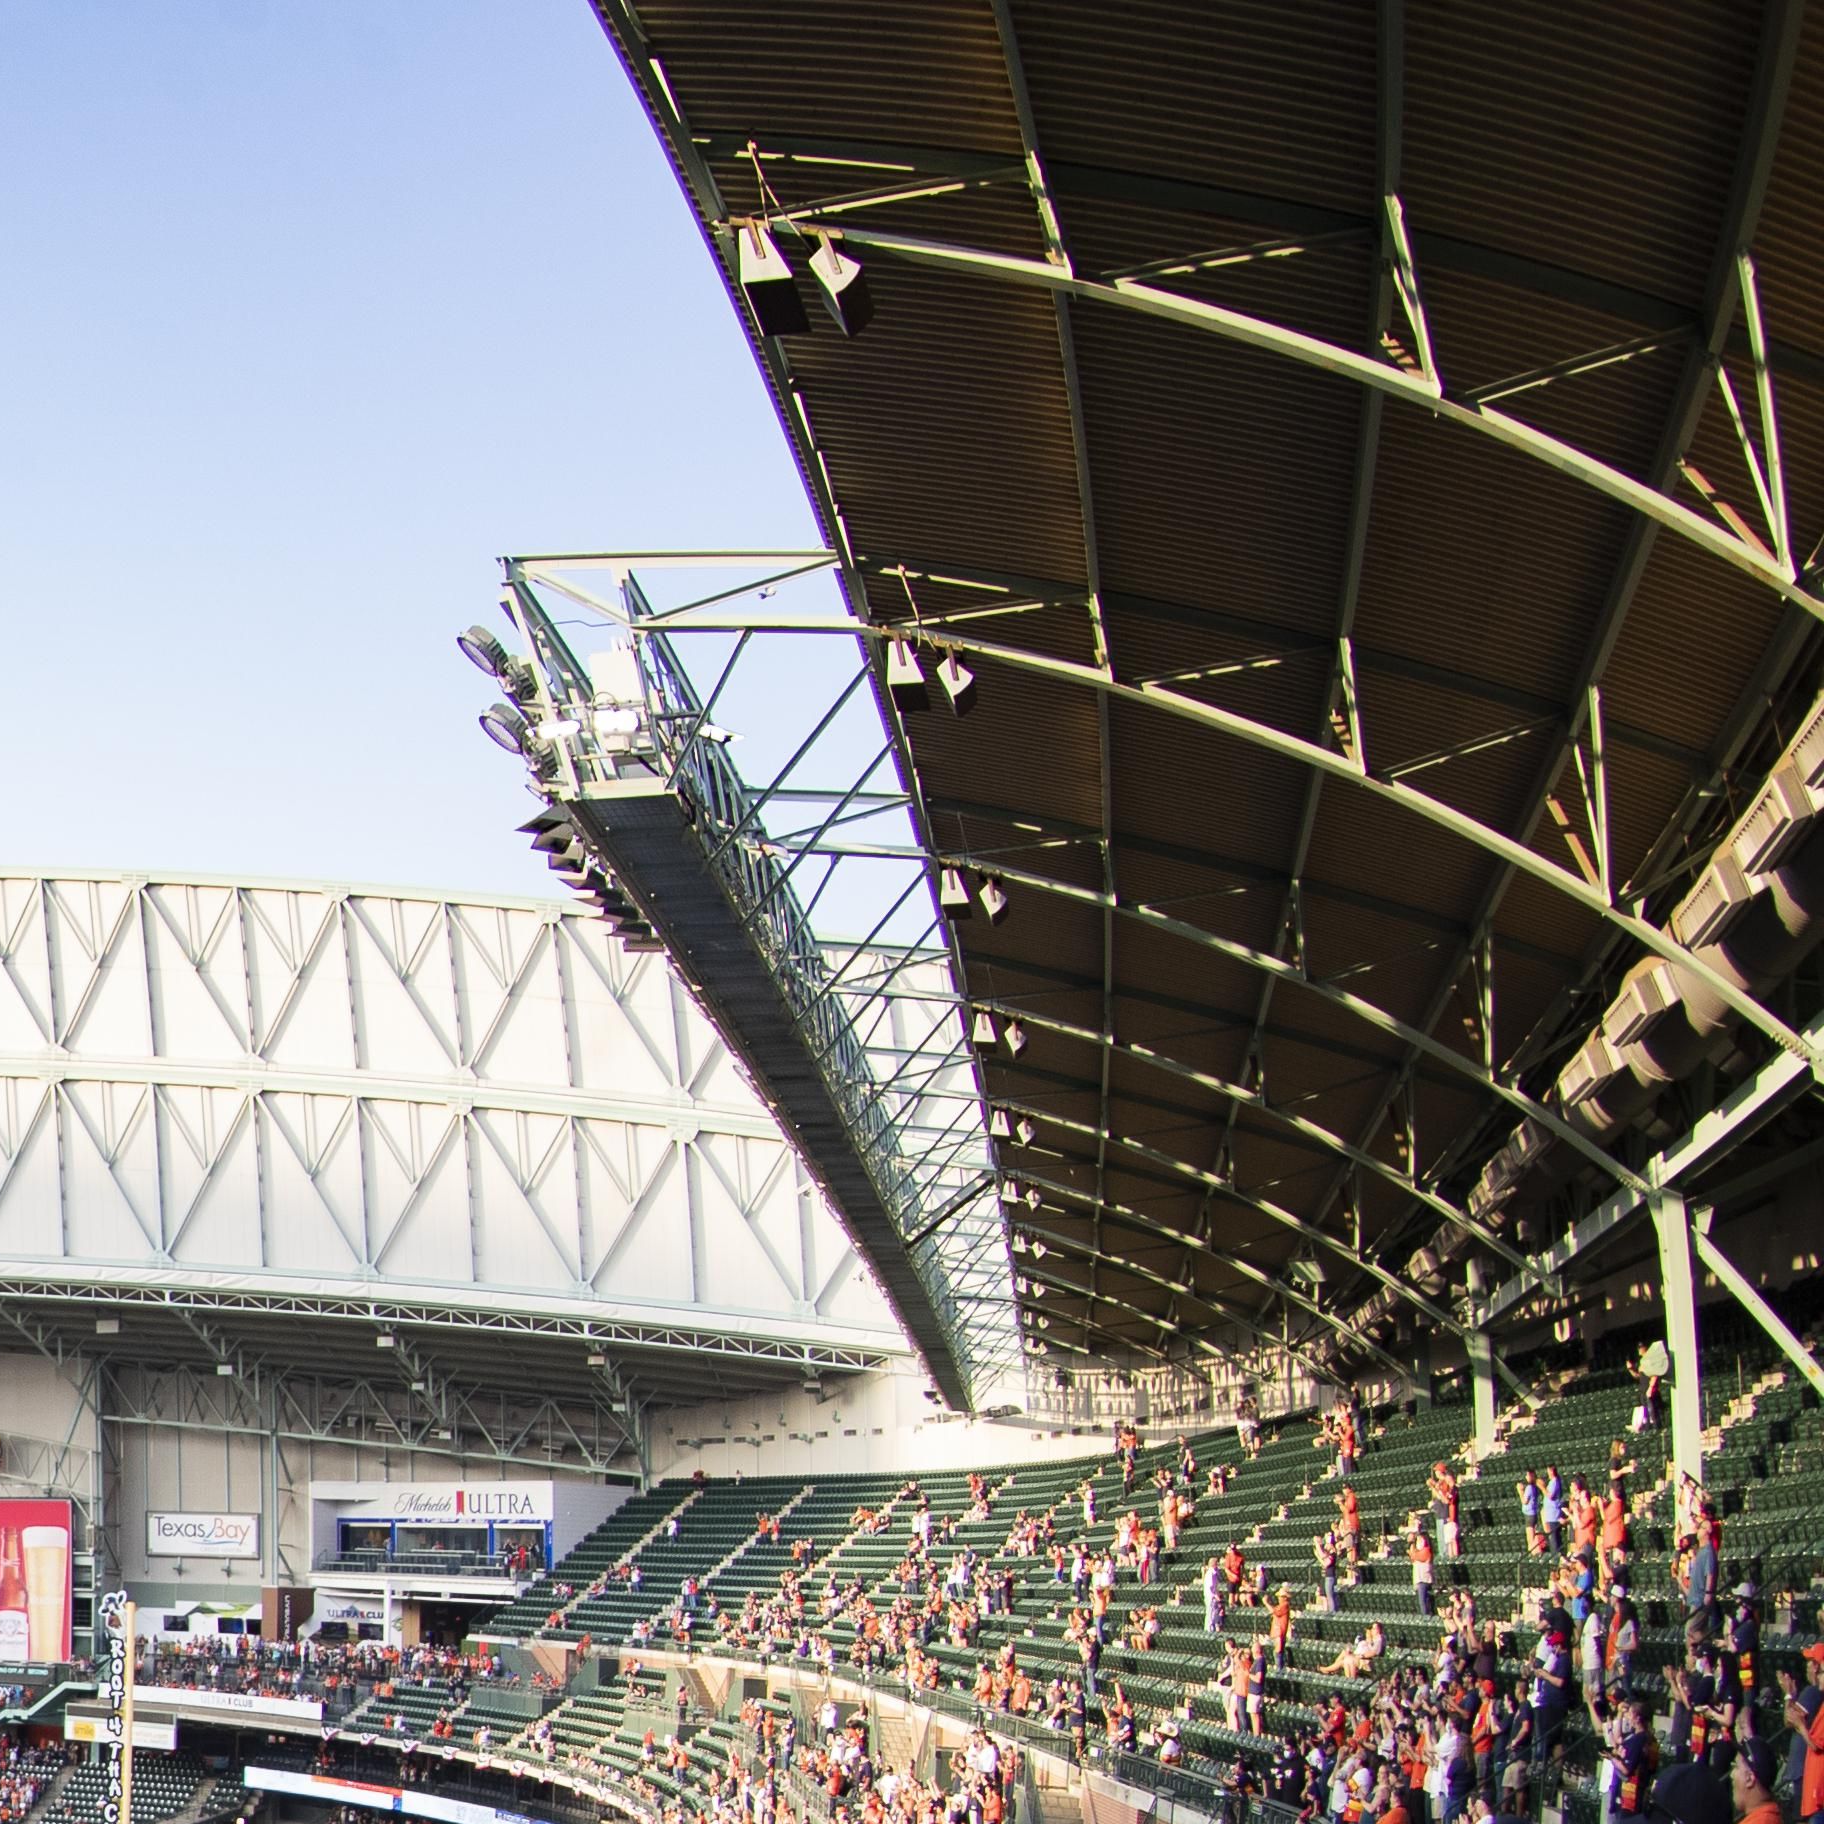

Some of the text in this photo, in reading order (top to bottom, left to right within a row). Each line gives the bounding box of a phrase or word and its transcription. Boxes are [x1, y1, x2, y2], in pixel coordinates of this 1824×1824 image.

[394, 1492, 535, 1515] Michelob ULTRA
[154, 1515, 251, 1546] Texas Bay
[327, 1608, 384, 1620] ULTRA CLU
[109, 1638, 125, 1710] ROOT
[233, 1697, 253, 1708] CLUB
[107, 1715, 122, 1737] 4
[107, 1741, 123, 1799] THA
